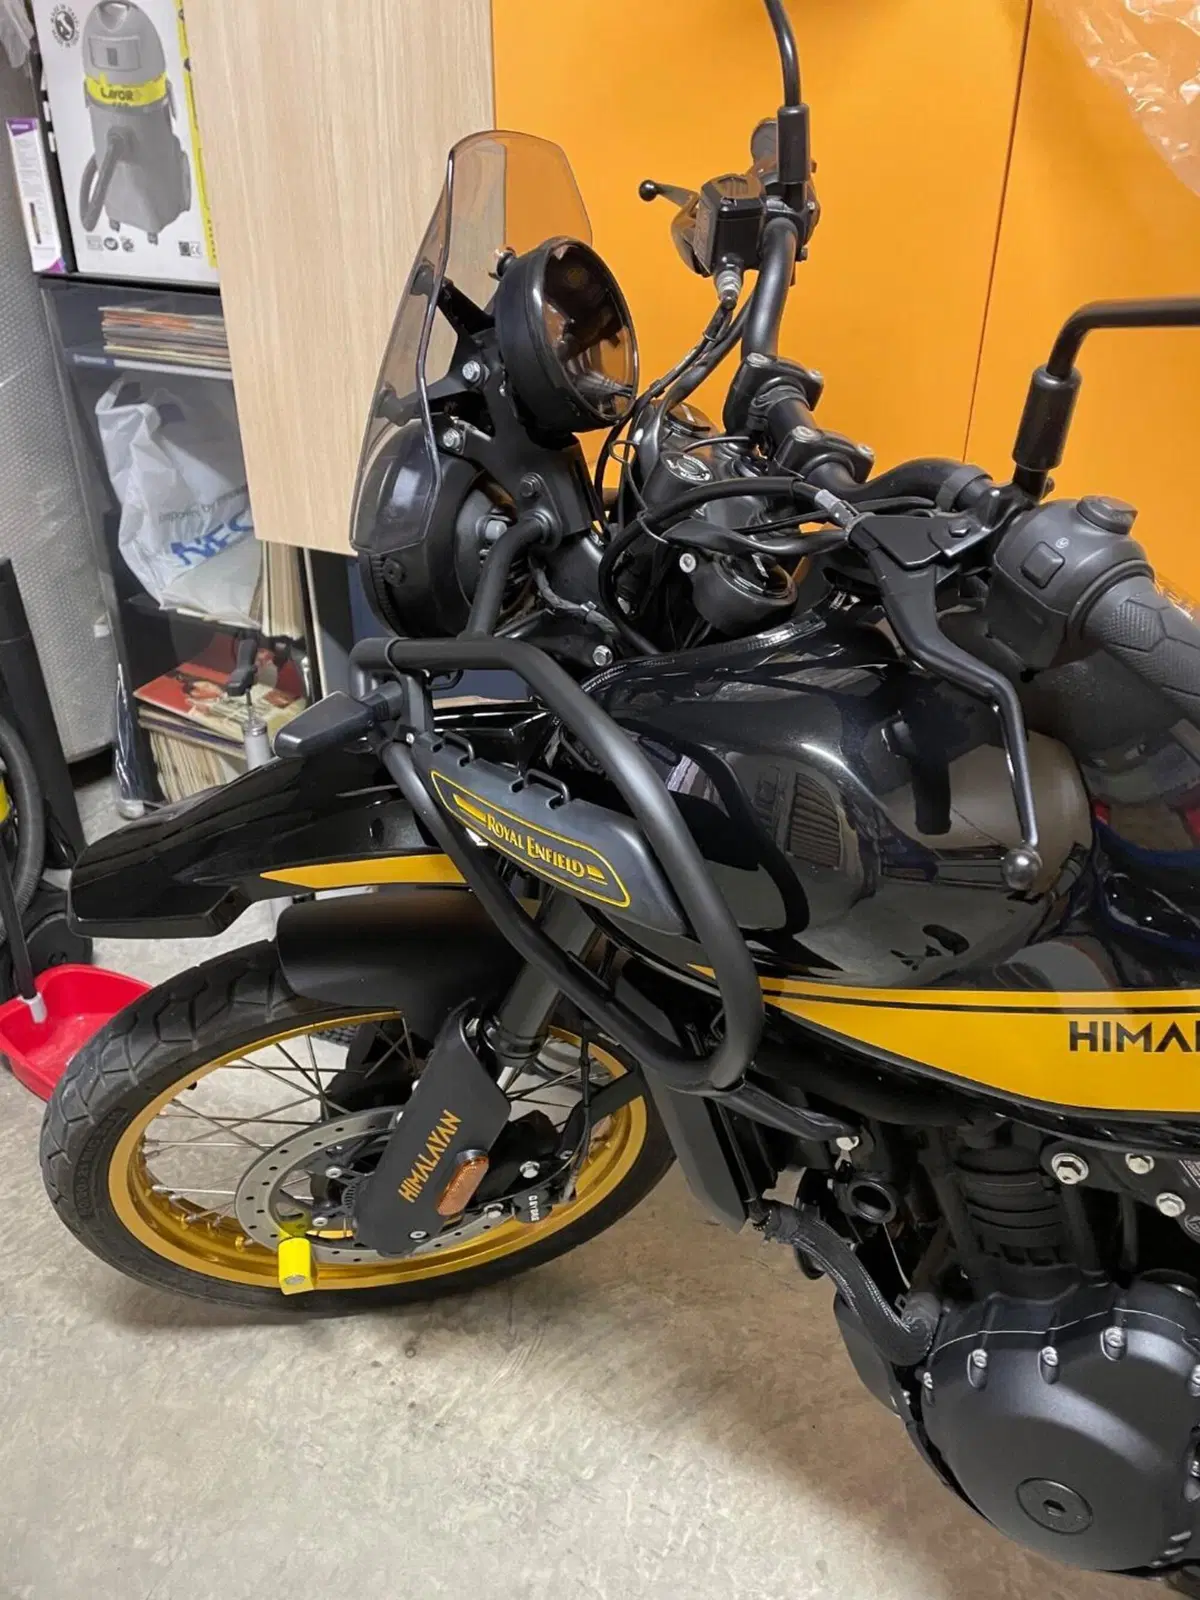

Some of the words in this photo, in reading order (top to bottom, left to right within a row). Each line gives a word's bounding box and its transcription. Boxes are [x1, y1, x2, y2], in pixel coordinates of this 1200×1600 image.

[486, 813, 525, 850] ROYAL
[526, 835, 585, 878] ENFIELD
[1068, 1020, 1200, 1053] HIMA
[397, 1109, 463, 1204] HIMALAYAN
